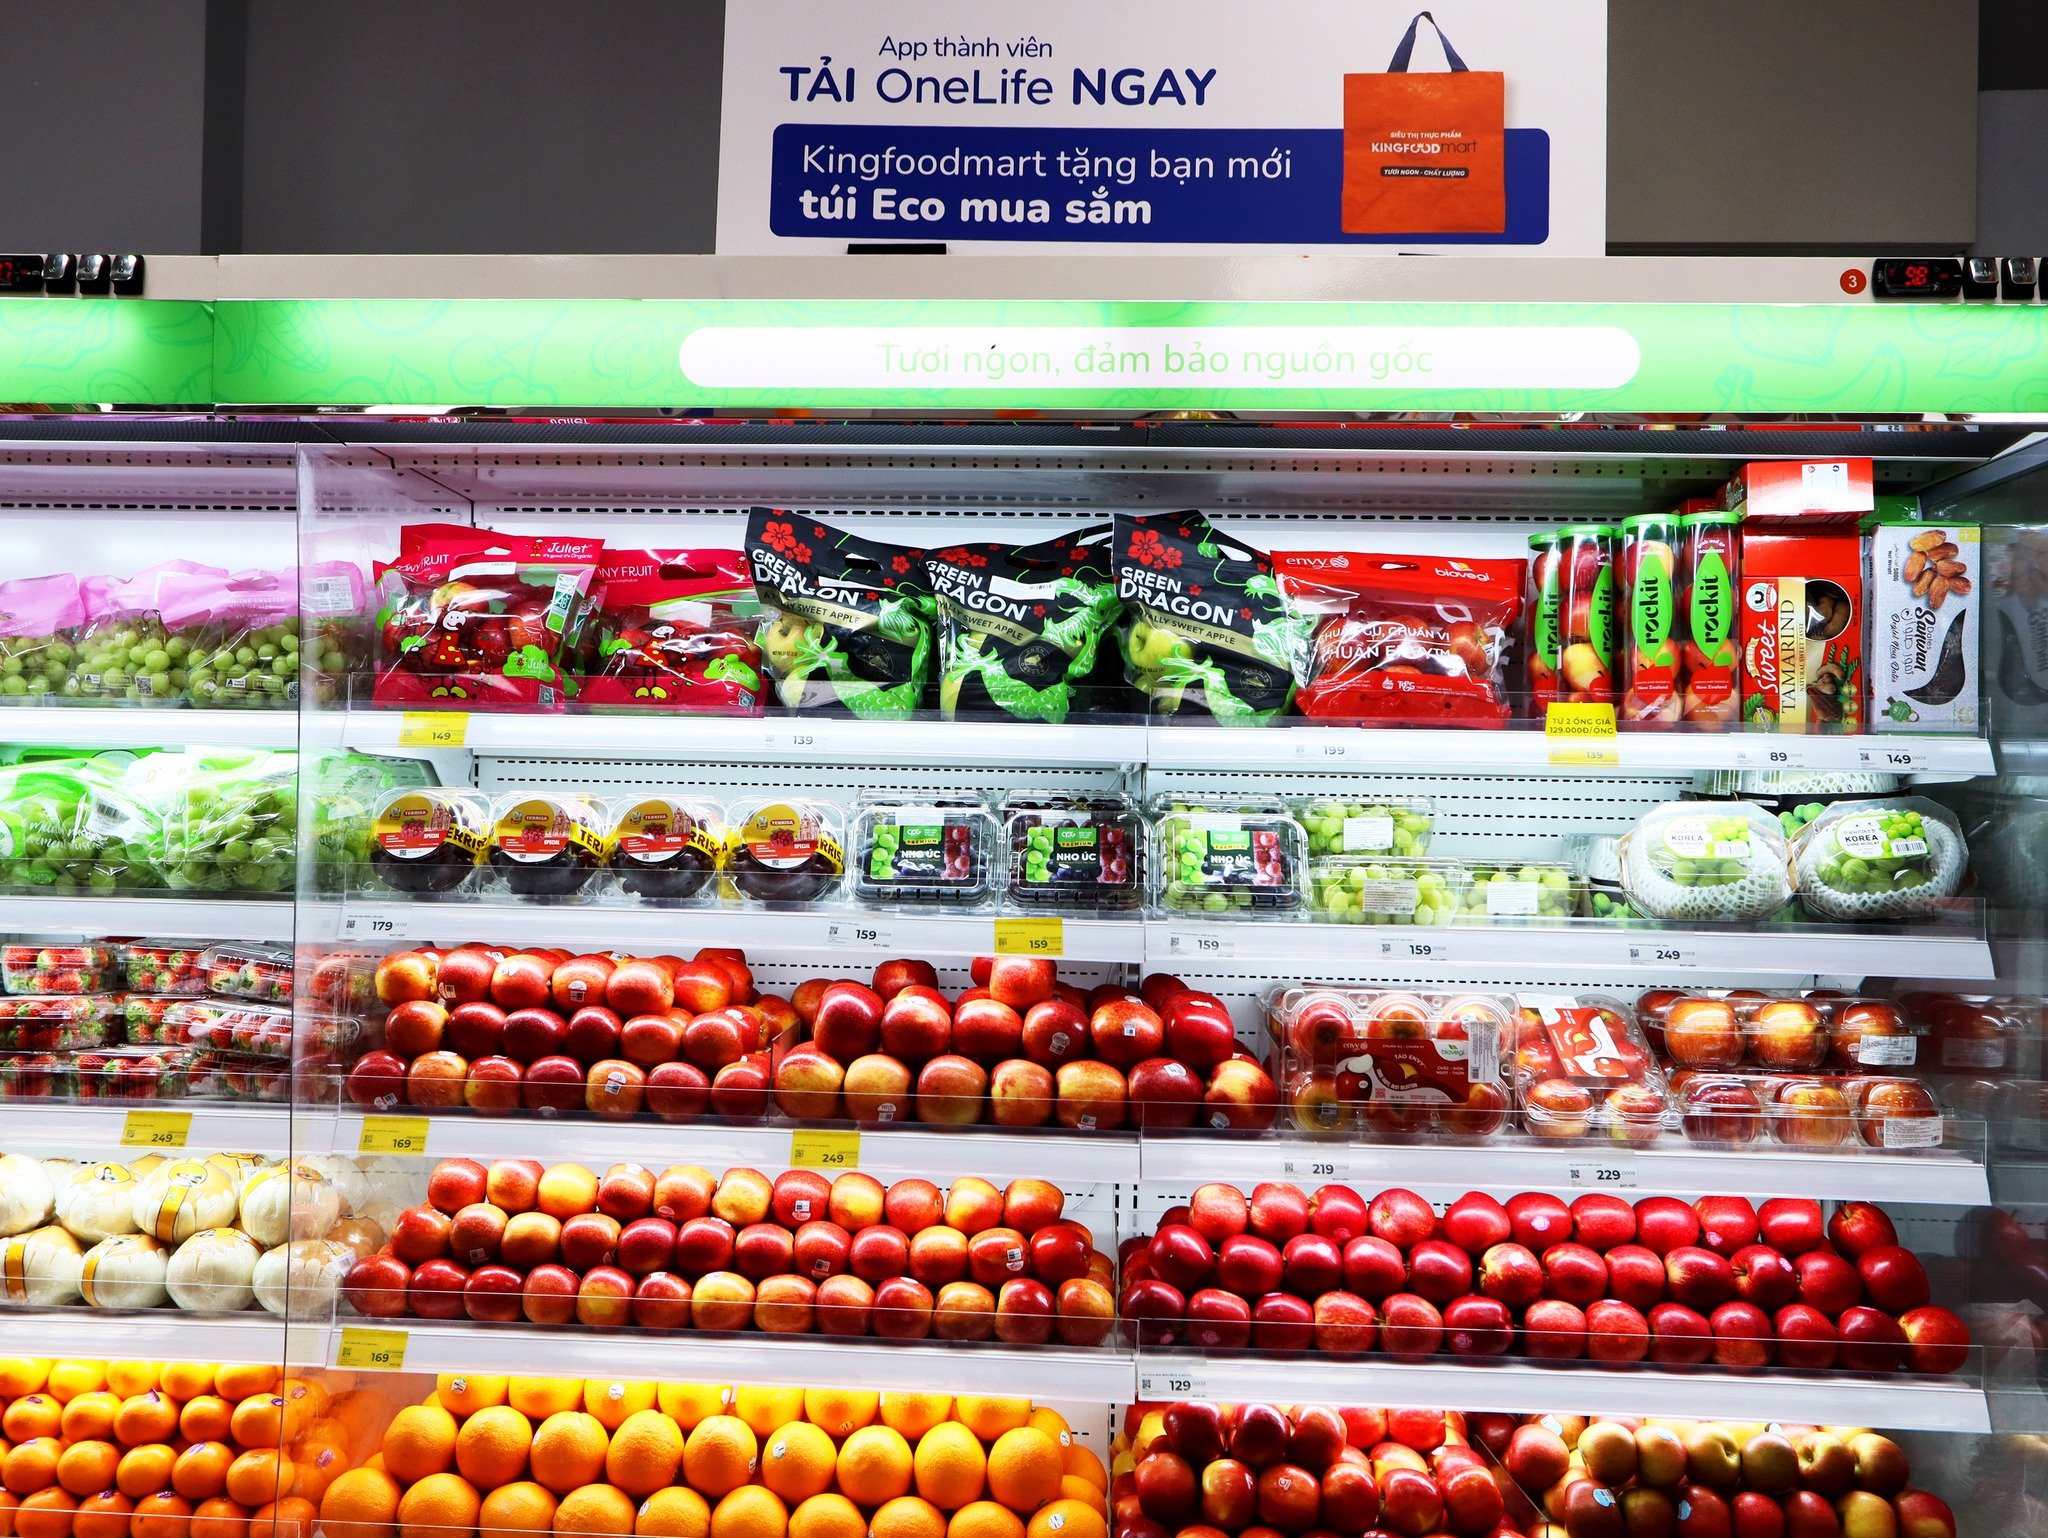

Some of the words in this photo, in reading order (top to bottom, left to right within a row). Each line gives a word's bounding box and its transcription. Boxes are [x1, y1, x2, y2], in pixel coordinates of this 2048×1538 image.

[878, 35, 928, 60] App
[933, 36, 1000, 58] thành
[1006, 37, 1053, 58] viên
[780, 56, 855, 103] TẢI
[876, 67, 1054, 105] OneLife
[1072, 67, 1217, 107] NGAY
[803, 144, 1046, 180] Kingfoodmart
[1057, 146, 1138, 184] tặng
[1150, 149, 1215, 186] bạn
[1228, 147, 1291, 180] mới
[799, 184, 857, 220] túi
[872, 188, 946, 223] Eco
[960, 198, 1051, 223] mua
[1065, 185, 1153, 225] sắm
[1849, 275, 1858, 288] 3
[876, 343, 950, 374] Tươi
[963, 351, 1060, 379] ngon,
[1074, 341, 1151, 373] đảm
[1164, 341, 1230, 374] bảo
[1243, 339, 1355, 379] nguồn
[1369, 340, 1434, 379] gốc
[548, 542, 588, 553] Juliet
[752, 549, 806, 585] GREEN
[1286, 556, 1328, 568] envy
[598, 567, 618, 578] NY
[621, 566, 653, 577] FRUIT
[925, 560, 982, 587] GREEN
[1434, 567, 1490, 581] biovegi
[1121, 567, 1181, 593] GREEN
[1121, 578, 1234, 626] DRAGON
[798, 604, 828, 615] SWEET
[830, 611, 860, 623] APPLE
[1639, 576, 1659, 643] rockit
[1699, 575, 1718, 642] rockit
[963, 615, 993, 627] SWEET
[994, 624, 1024, 640] APPLE
[1172, 621, 1204, 634] SWEET
[1205, 631, 1235, 644] APPLE
[1914, 607, 1936, 671] Sanwan
[1745, 644, 1757, 670] Fresh
[1757, 619, 1779, 693] Sweet
[1780, 600, 1796, 713] TAMARIND
[433, 732, 450, 740] 149
[793, 736, 813, 744] 139
[1323, 746, 1345, 754] 199
[1770, 752, 1787, 761] 89
[1887, 754, 1911, 764] 149
[927, 849, 941, 858] ÚC
[1057, 853, 1079, 861] NHO
[1082, 851, 1096, 861] ÚC
[1211, 854, 1234, 863] NHO
[372, 921, 393, 930] 179
[855, 929, 877, 940] 159
[1029, 939, 1048, 948] 159
[1198, 939, 1219, 950] 159
[1409, 944, 1432, 955] 159
[1656, 950, 1680, 960] 249
[151, 1134, 172, 1142] 249
[393, 1139, 411, 1147] 169
[822, 1154, 843, 1162] 249
[1312, 1164, 1333, 1174] 219
[1597, 1170, 1620, 1180] 229
[371, 1353, 389, 1362] 169
[1169, 1380, 1191, 1391] 129
